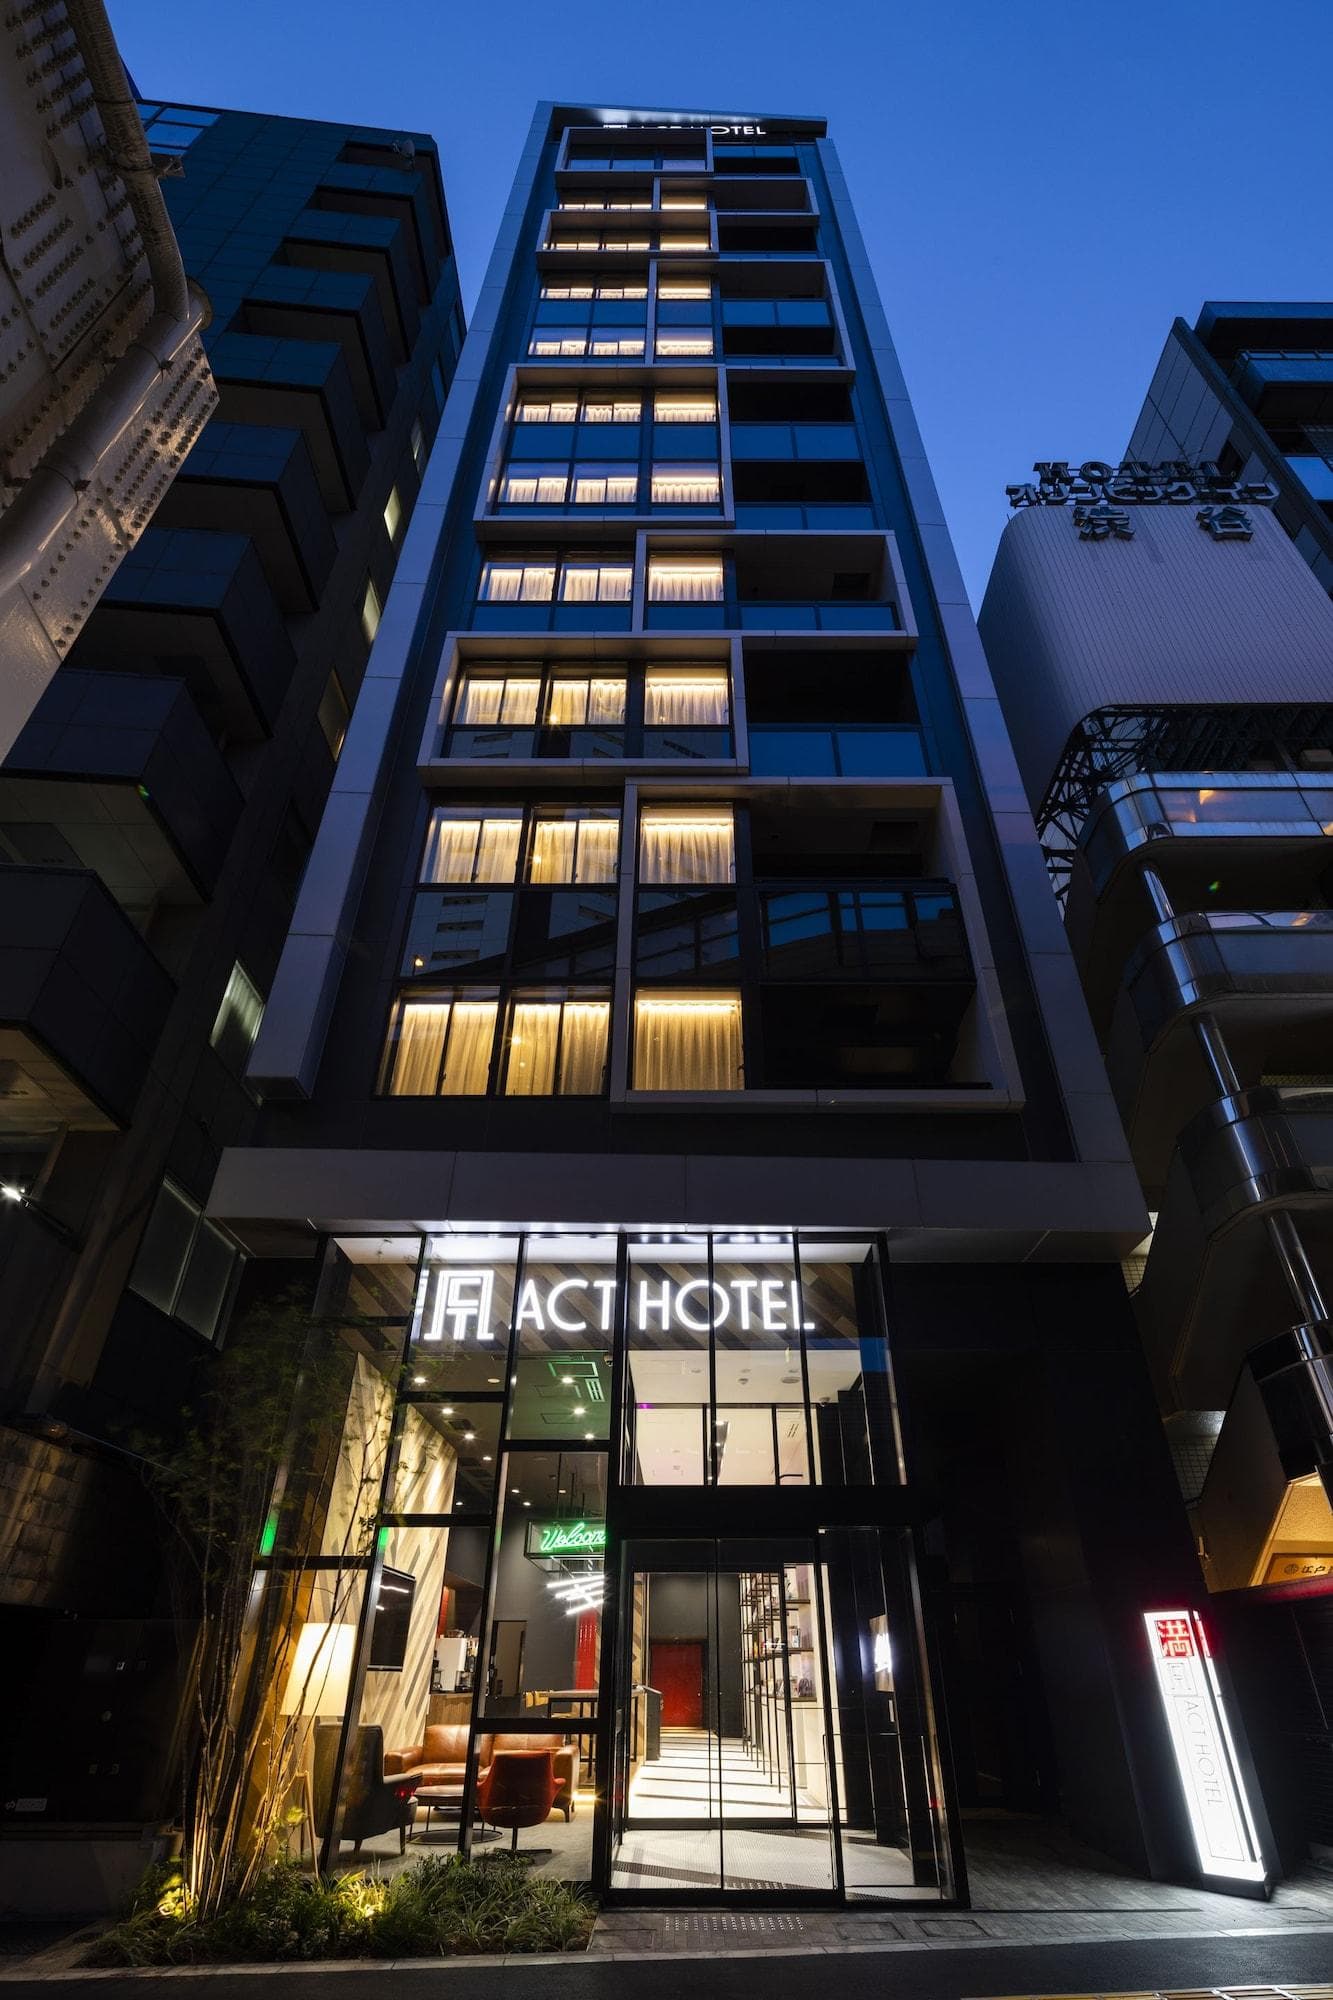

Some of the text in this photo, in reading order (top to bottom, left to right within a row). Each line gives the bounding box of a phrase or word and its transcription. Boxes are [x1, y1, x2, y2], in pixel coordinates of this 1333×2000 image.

[509, 1278, 815, 1331] ACT HOTEL
[541, 1521, 605, 1551] Welcom
[1186, 1700, 1222, 1805] ACT HOTEL
